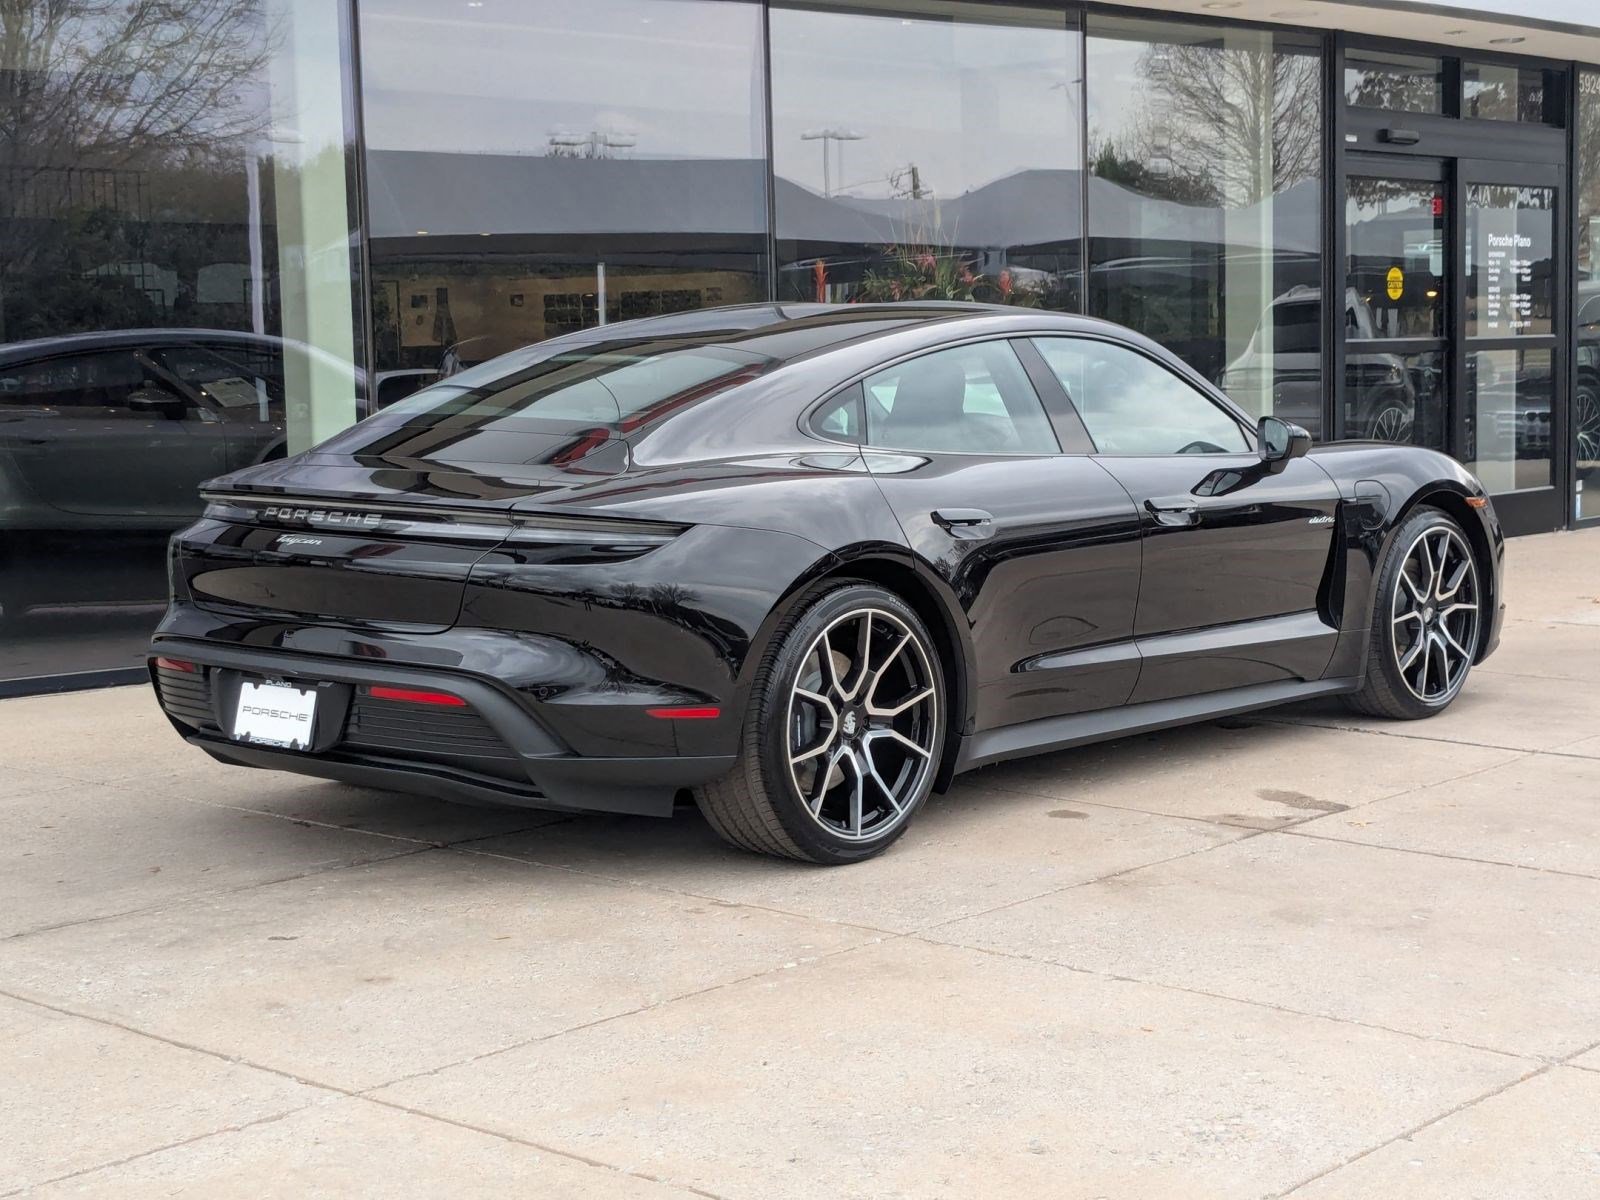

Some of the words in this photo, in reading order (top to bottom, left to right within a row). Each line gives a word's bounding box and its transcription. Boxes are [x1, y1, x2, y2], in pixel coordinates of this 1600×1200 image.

[1488, 233, 1513, 247] Porsche
[1514, 234, 1531, 248] Plano
[264, 506, 383, 526] PORSCHE
[275, 533, 323, 546] Taycan
[265, 679, 292, 688] PLANO
[242, 705, 309, 722] PORSCHE
